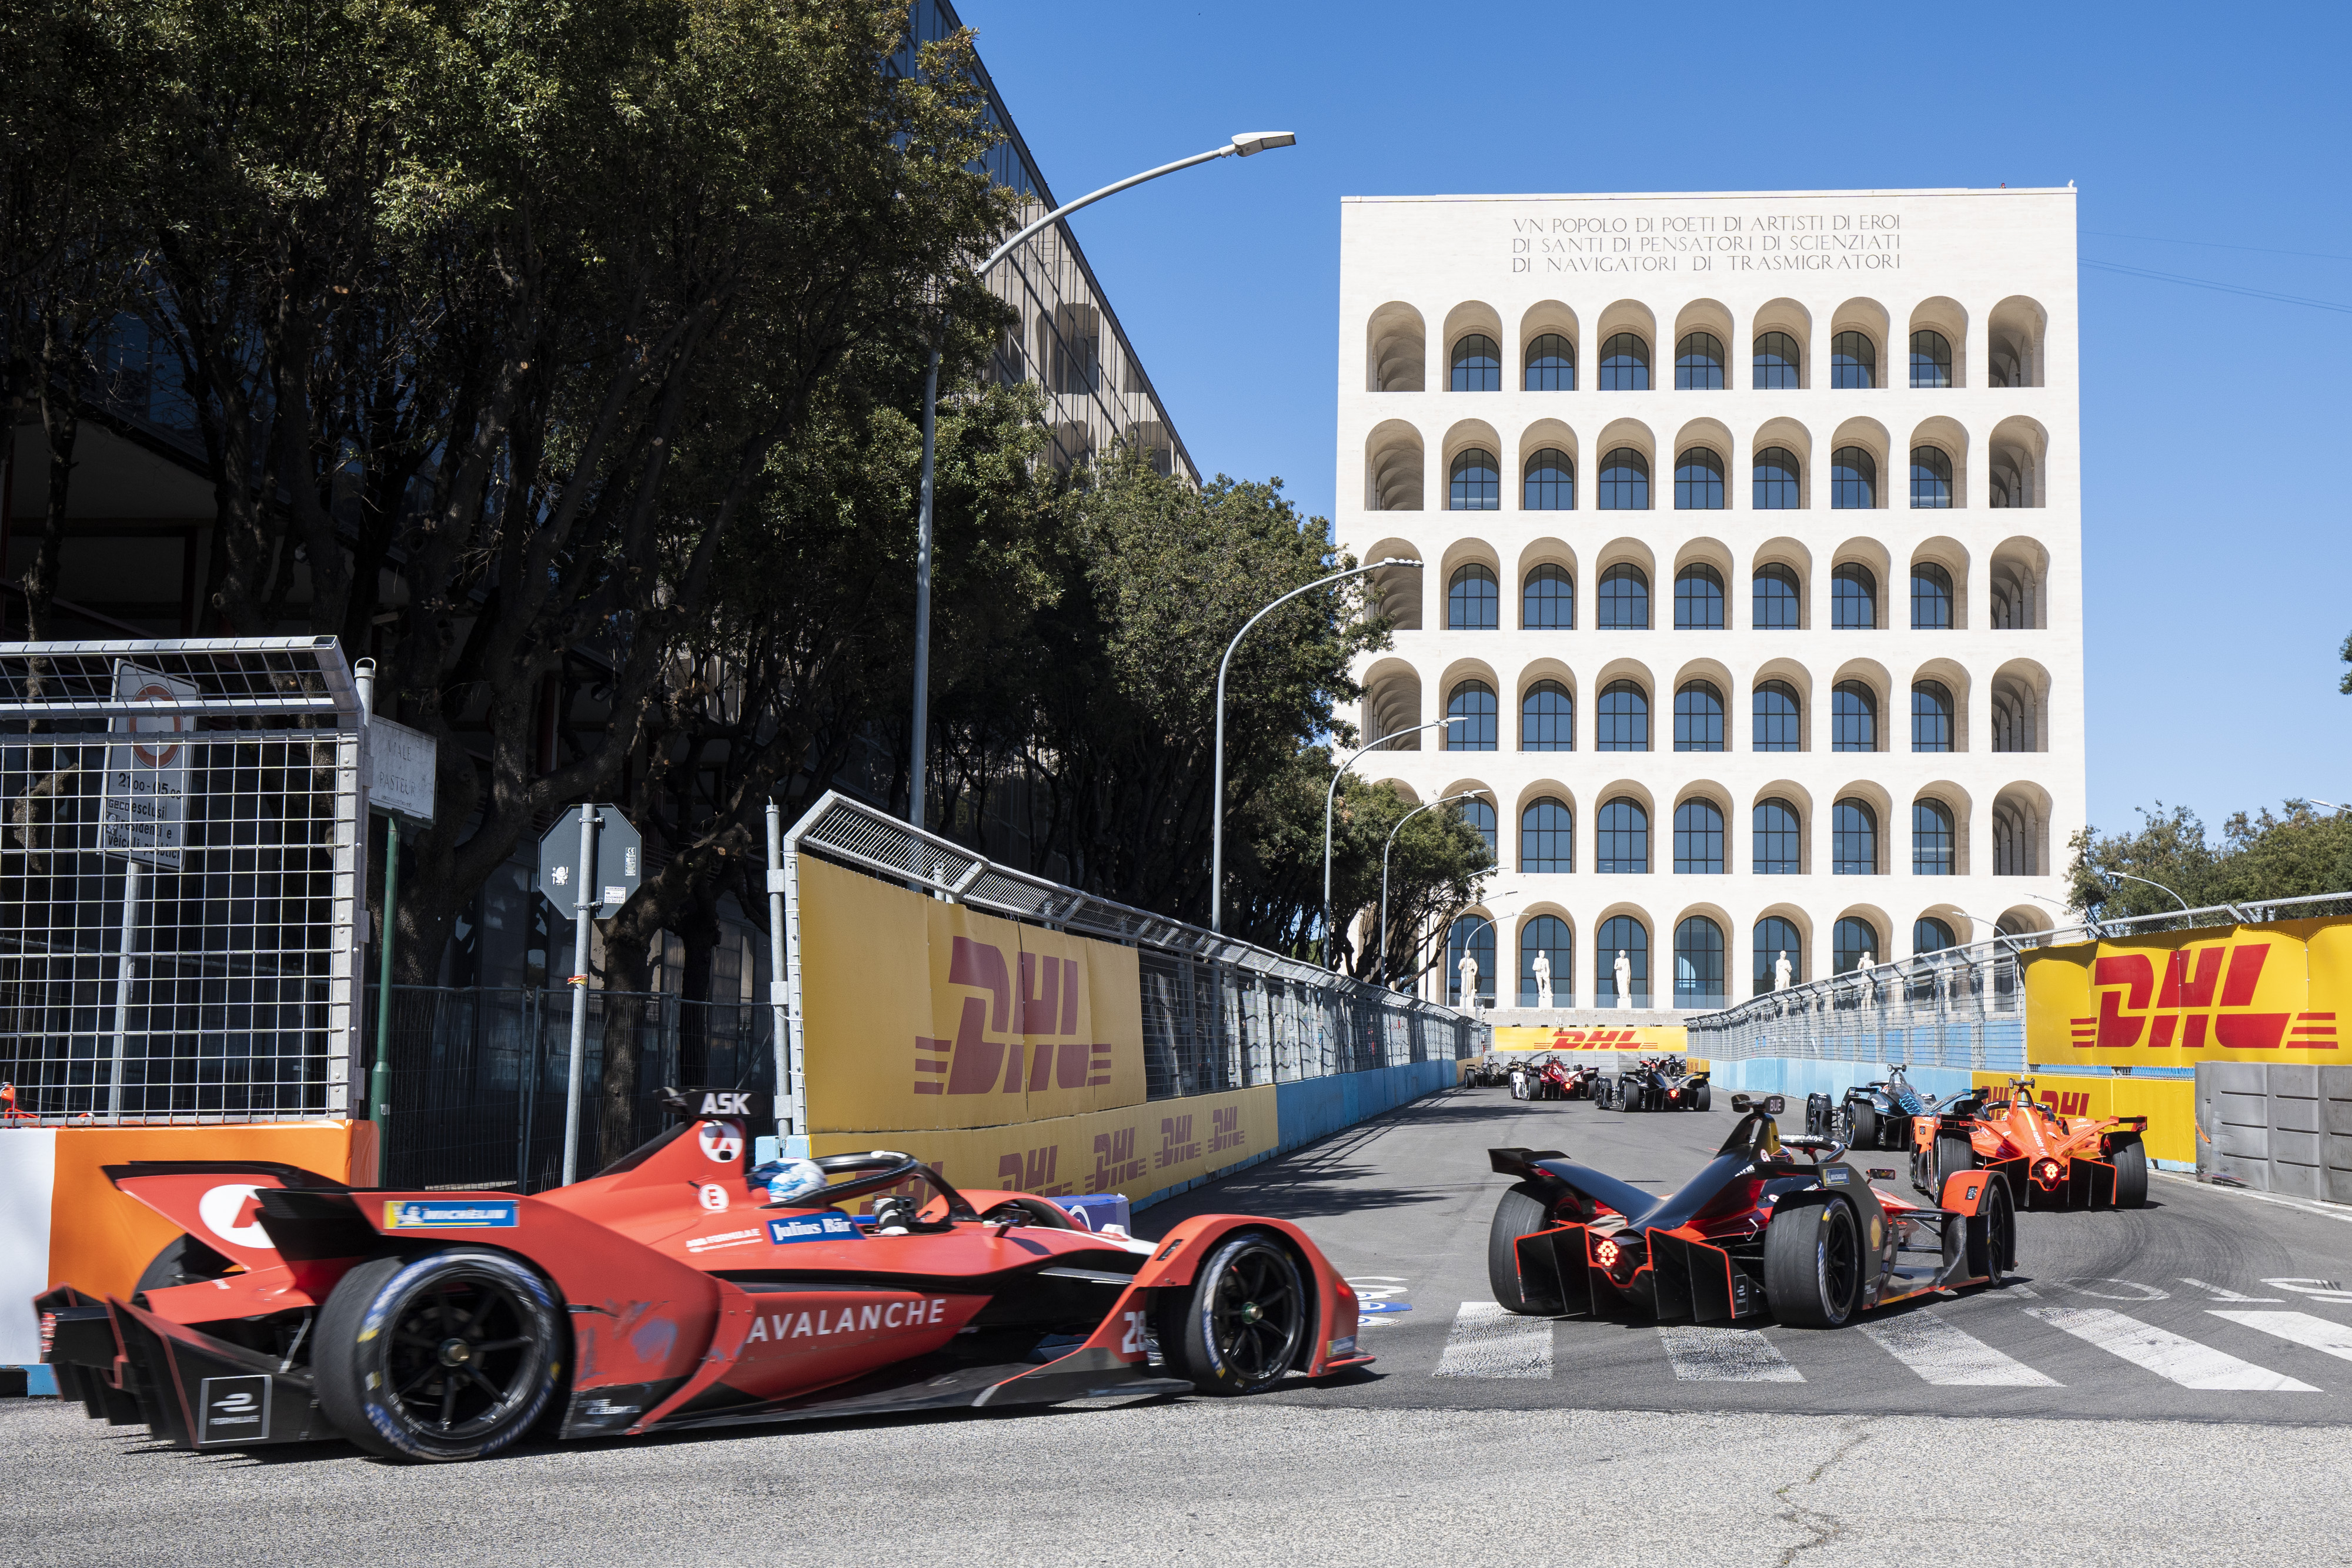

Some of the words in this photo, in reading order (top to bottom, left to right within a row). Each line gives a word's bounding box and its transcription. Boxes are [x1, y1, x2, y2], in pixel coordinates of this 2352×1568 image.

[1512, 218, 1544, 233] VN
[1553, 218, 1627, 233] POPOLO
[1636, 217, 1653, 232] DI
[1662, 216, 1714, 232] POETI
[1724, 216, 1741, 232] DI
[1751, 215, 1823, 231] ARTISTI
[1833, 215, 1850, 230] DI
[1859, 215, 1900, 230] EROI
[1512, 238, 1530, 253] DI
[1542, 237, 1602, 253] SANTI
[1613, 237, 1631, 252] DI
[1641, 236, 1752, 252] PENSATORI
[1763, 236, 1780, 251] DI
[1790, 235, 1900, 250] SCIENZIATI
[1512, 258, 1530, 273] DI
[1547, 256, 1676, 273] NAVIGATORI
[1693, 256, 1711, 271] DI
[1727, 254, 1900, 270] TRASMIGRATORI
[388, 740, 411, 761] VIALE
[380, 772, 415, 797] PASTEUR
[132, 803, 165, 819] esclusi
[108, 835, 139, 850] veicoli
[166, 830, 172, 839] e
[2094, 944, 2291, 1048] DHL
[947, 935, 1090, 1095] DHL
[1551, 1031, 1641, 1049] DHL
[700, 1093, 751, 1115] ASK
[1770, 1099, 1781, 1111] BUE
[1212, 1106, 1240, 1152] DHL
[1161, 1114, 1195, 1167] DHL
[998, 1145, 1062, 1196] DHL
[1094, 1127, 1138, 1192] DHL
[771, 1221, 823, 1241] Julius
[821, 1218, 851, 1233] Bär
[745, 1299, 946, 1344] AVALANCHE
